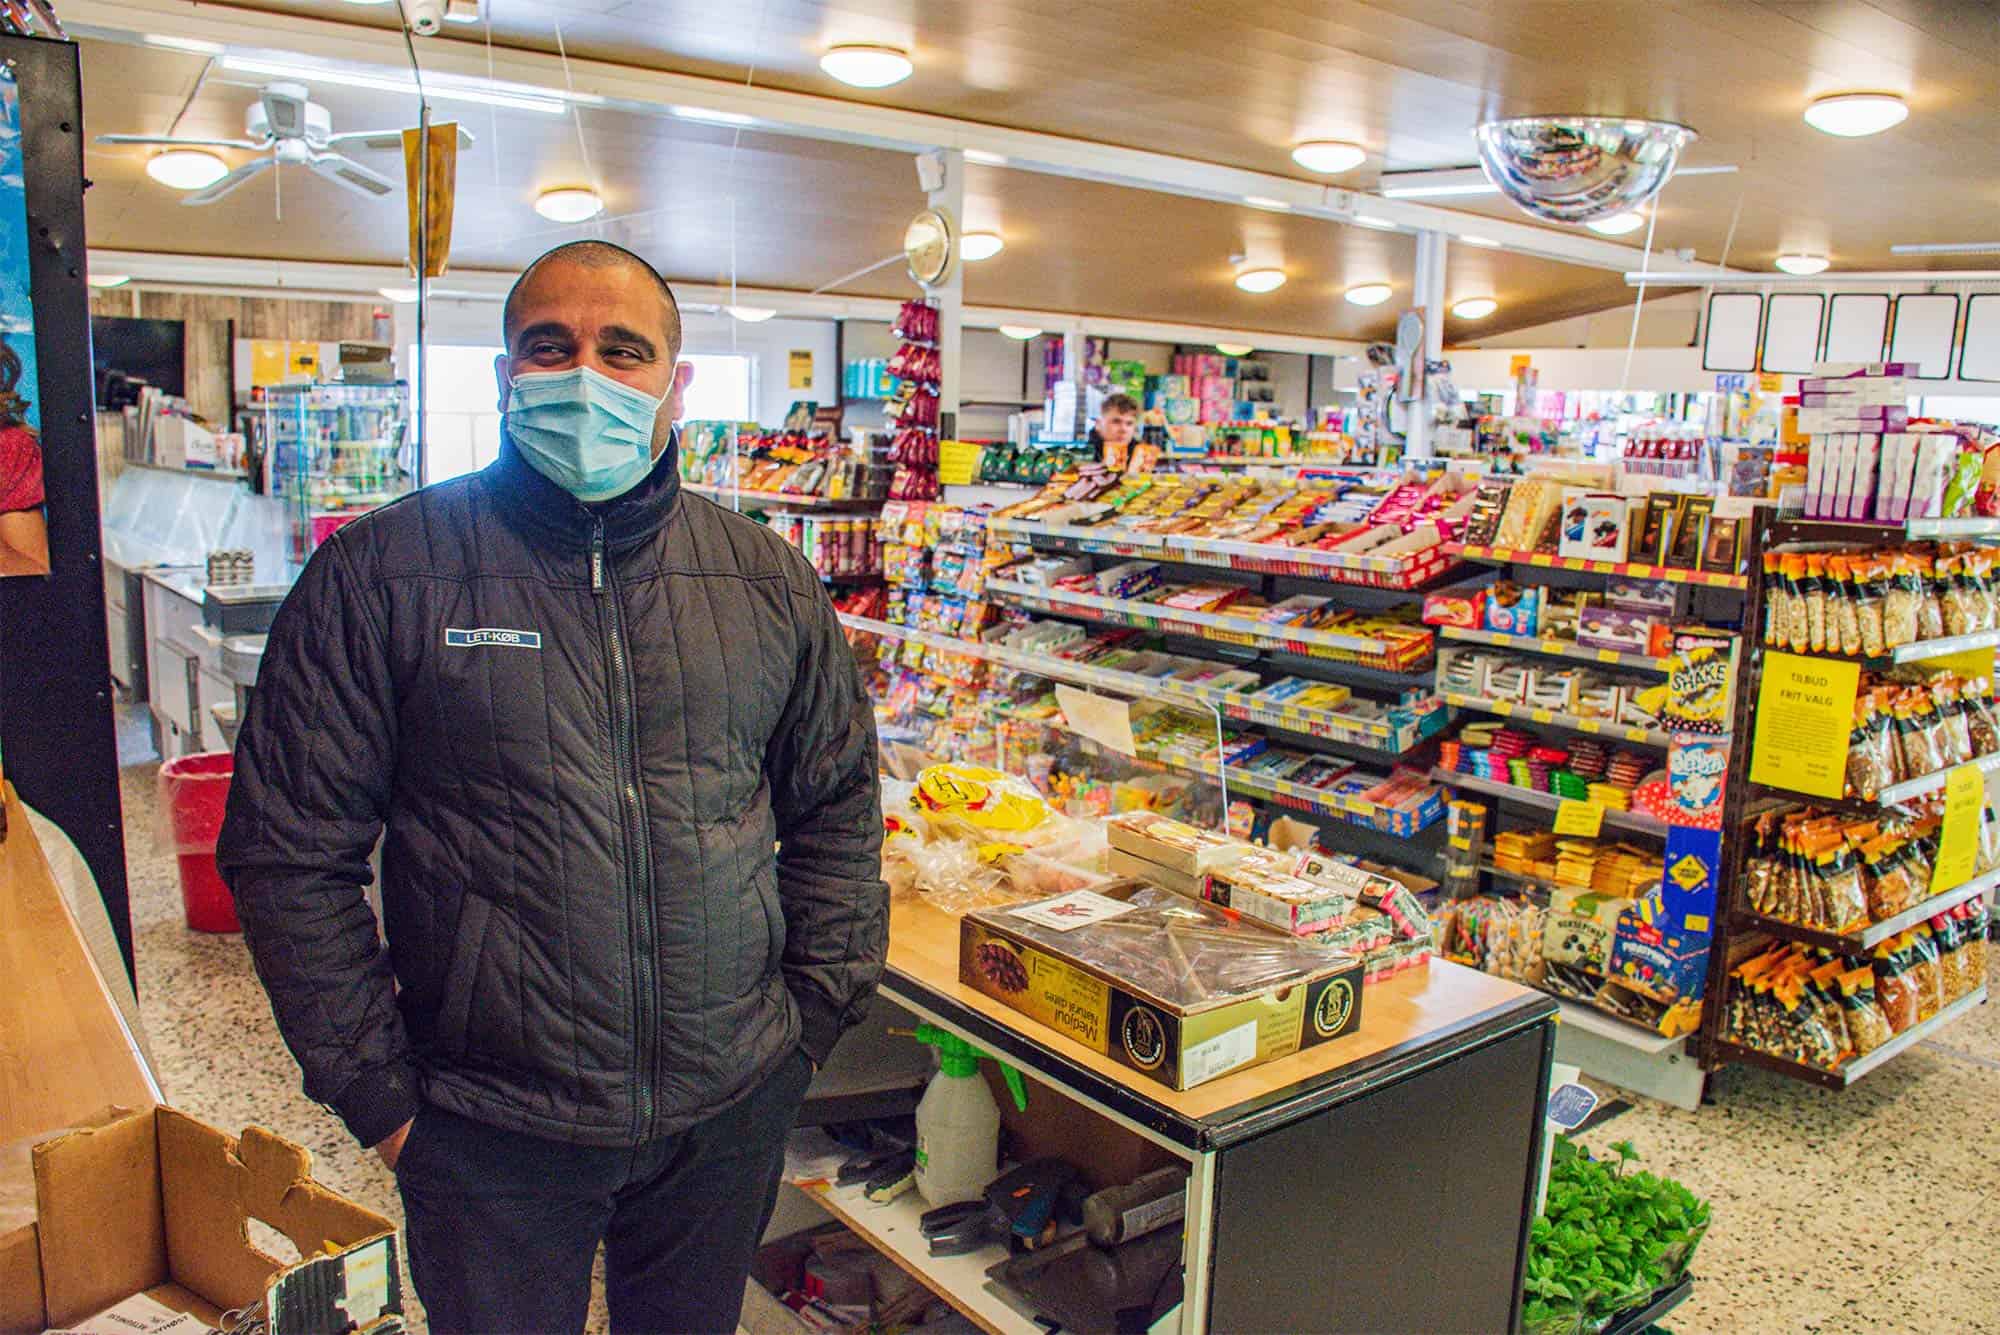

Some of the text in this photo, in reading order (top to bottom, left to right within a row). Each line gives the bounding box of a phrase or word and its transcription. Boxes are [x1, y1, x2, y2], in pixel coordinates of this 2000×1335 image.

[466, 632, 520, 643] LET-KØB
[1672, 662, 1728, 692] SHAKE
[1780, 688, 1833, 707] FRIT VALG
[1054, 1007, 1098, 1042] Medjoul
[1069, 1002, 1100, 1026] Natural
